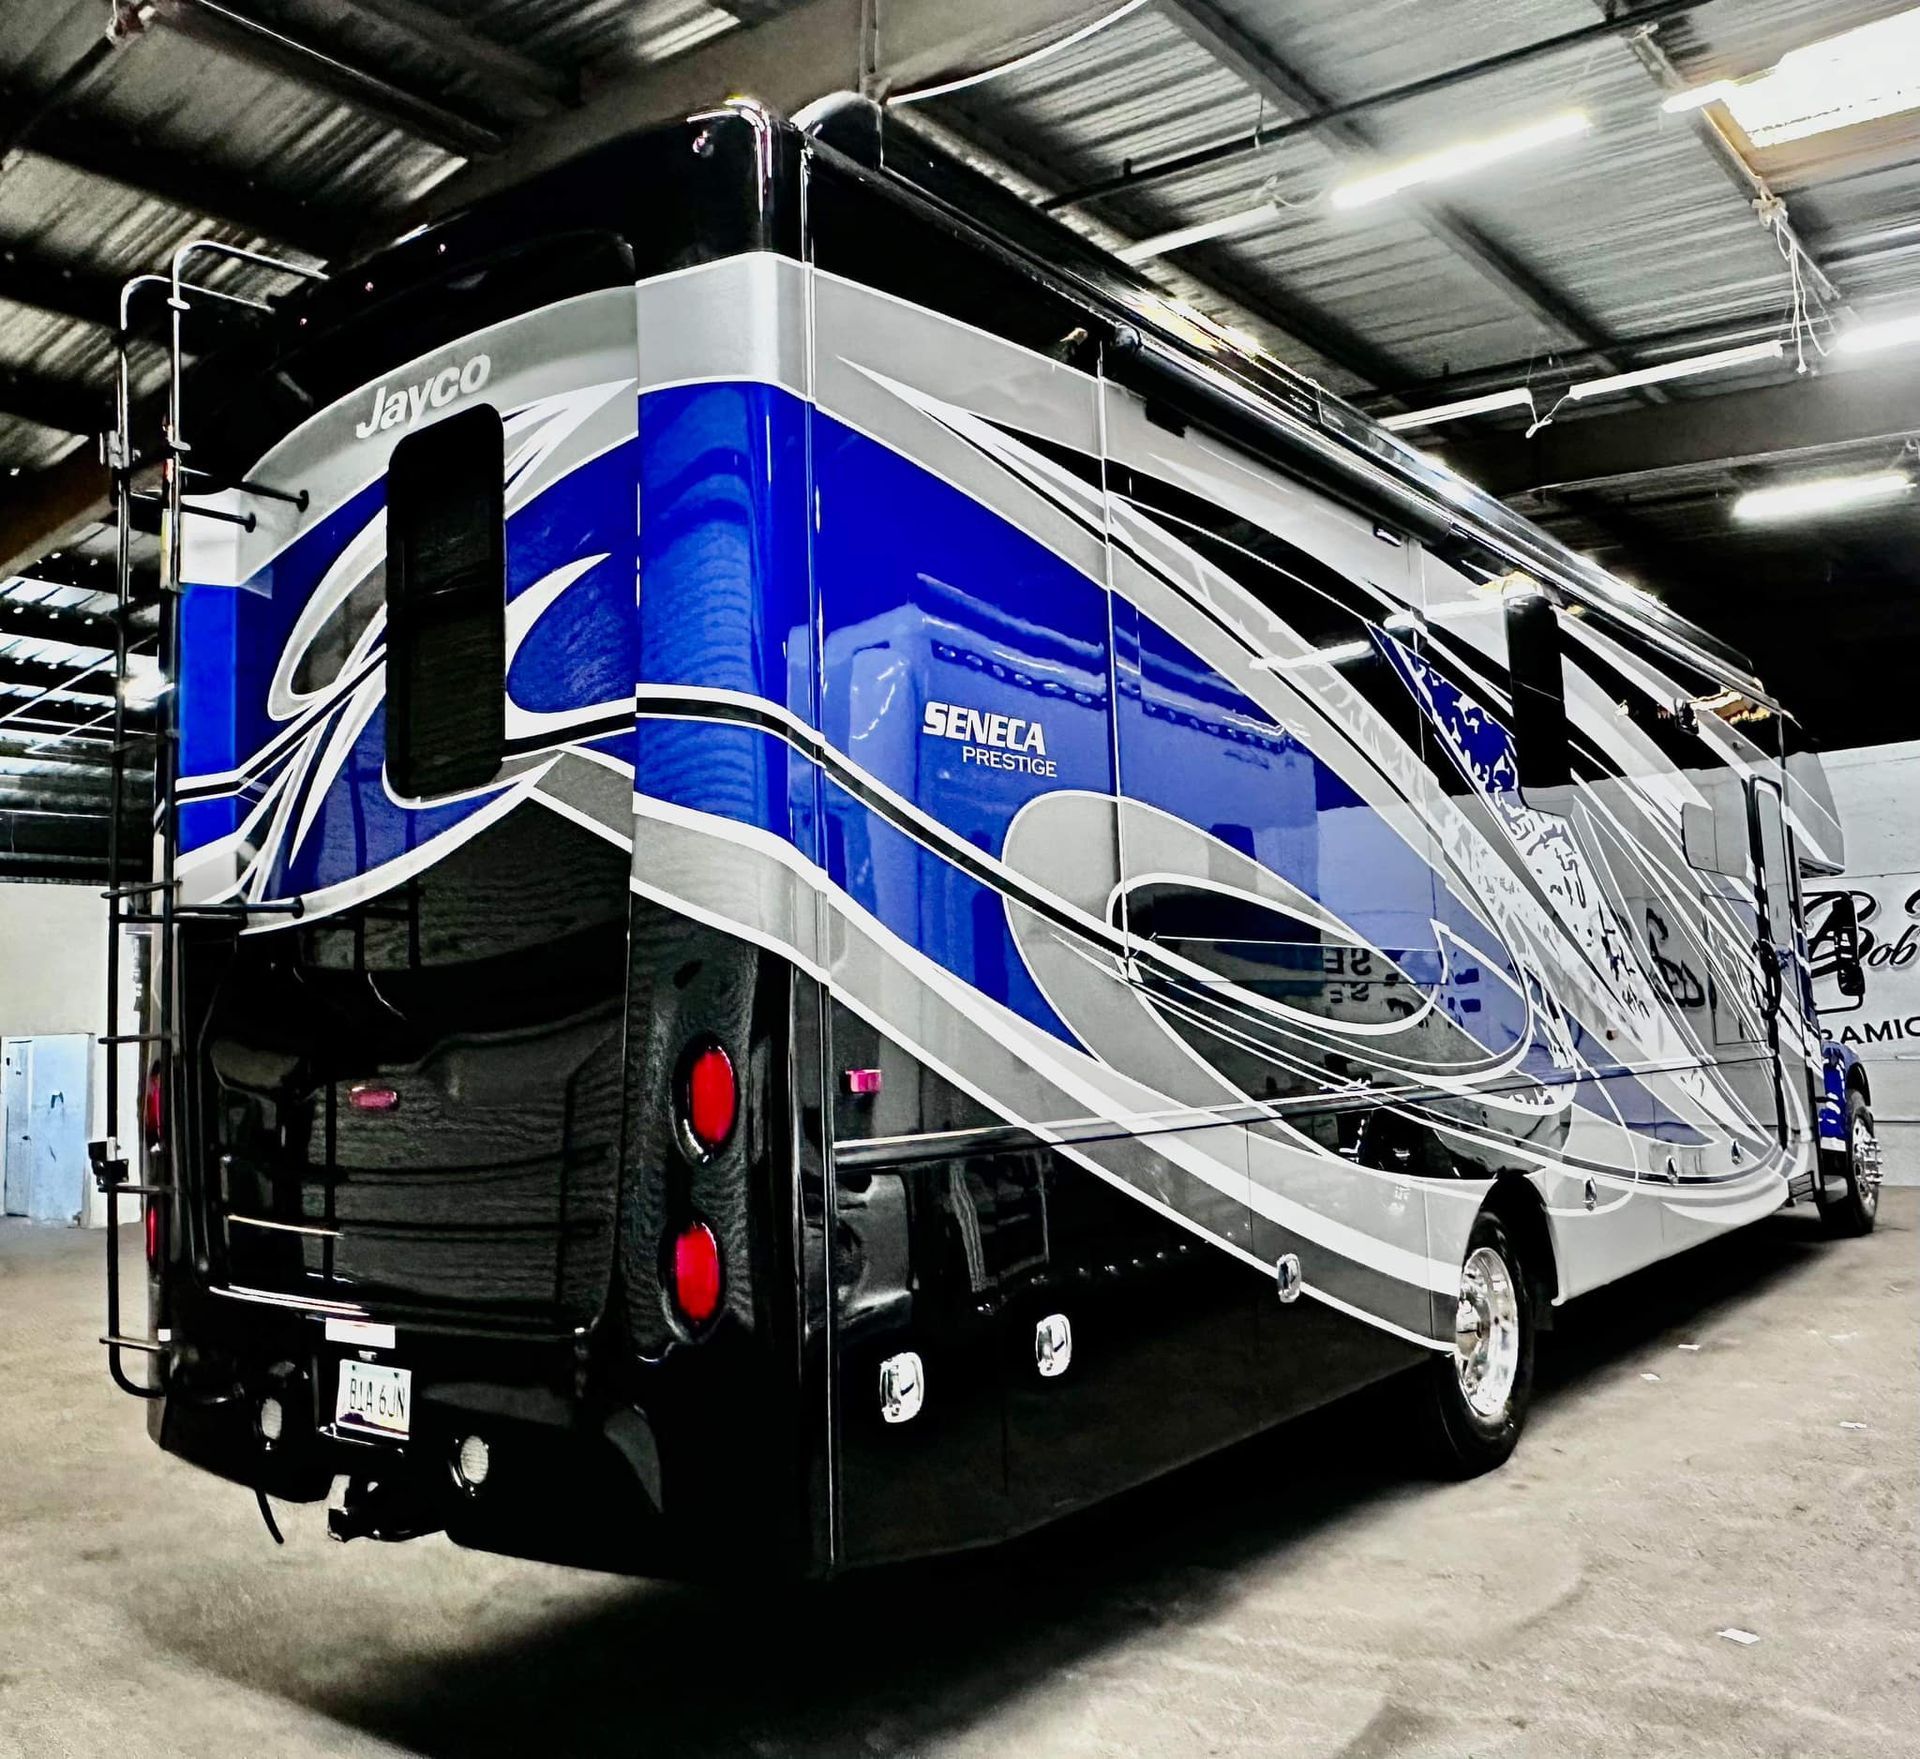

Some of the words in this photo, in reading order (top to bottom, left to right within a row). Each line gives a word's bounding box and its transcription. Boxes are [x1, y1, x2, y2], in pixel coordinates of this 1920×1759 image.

[356, 353, 491, 439] Jayco
[922, 701, 1046, 756] SENECA
[962, 745, 1057, 778] PRESTIGE
